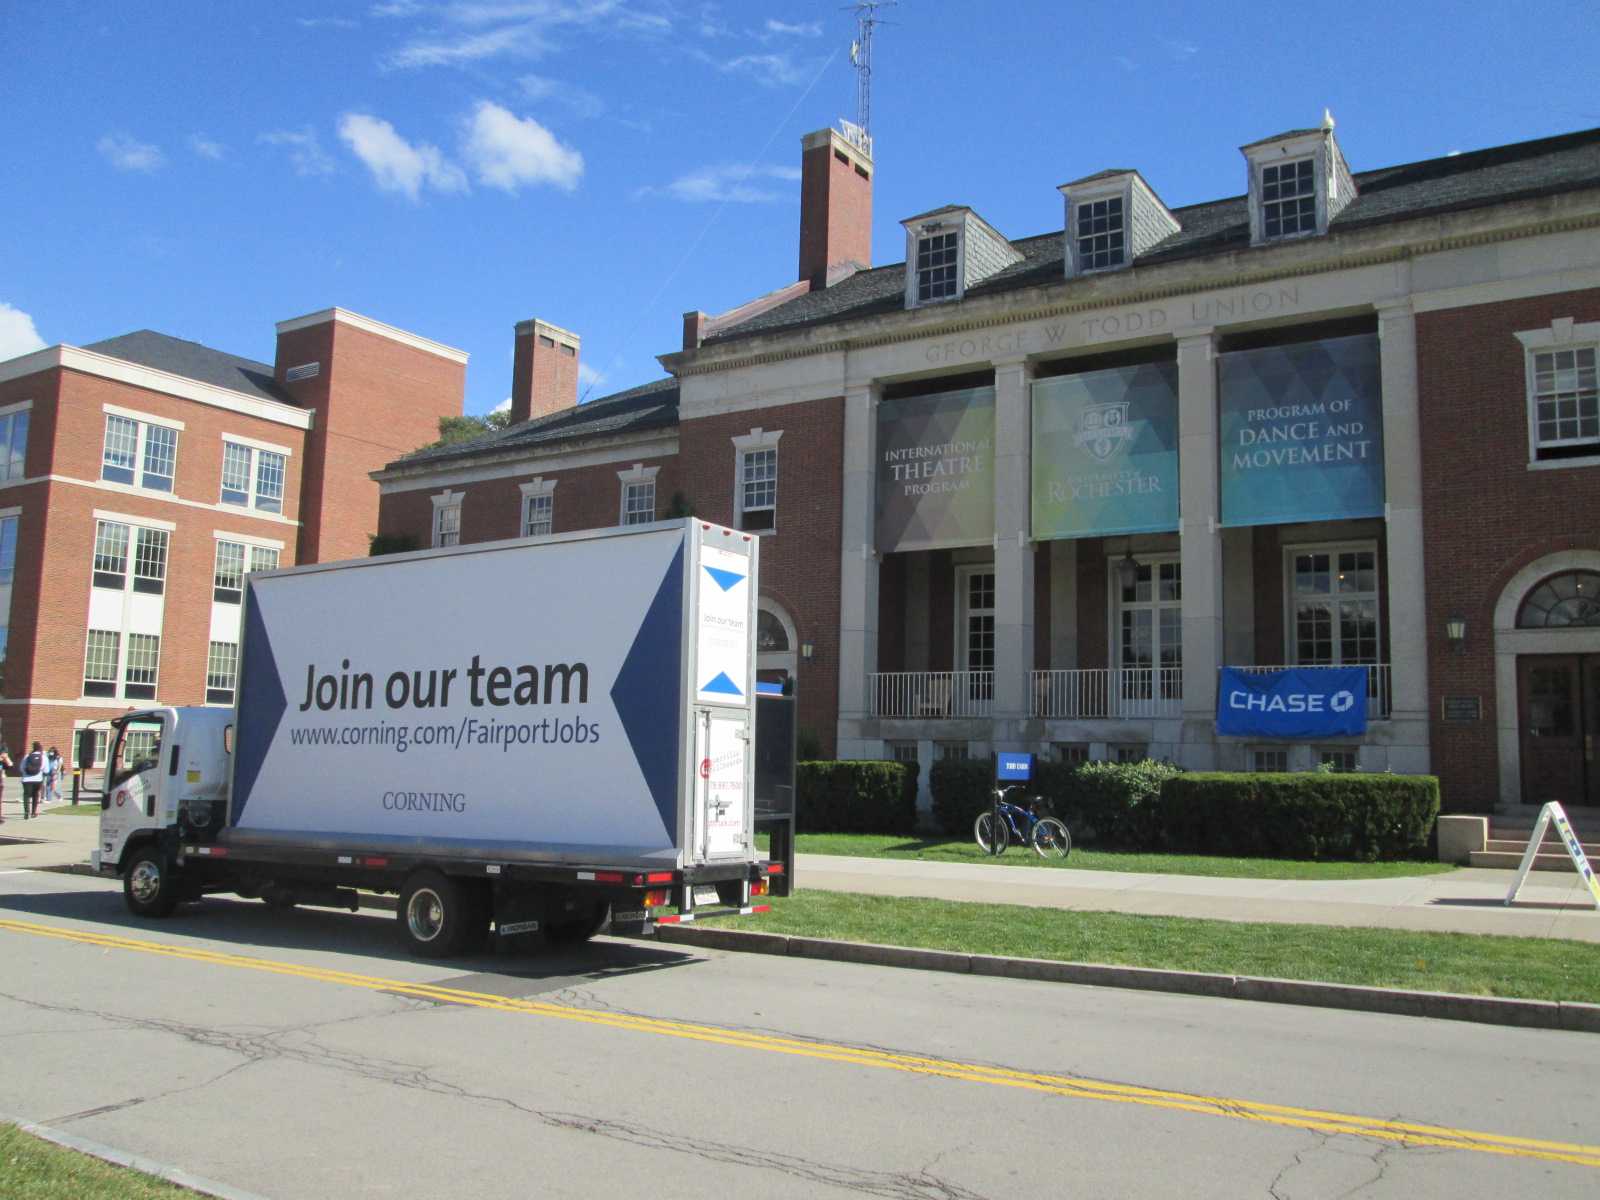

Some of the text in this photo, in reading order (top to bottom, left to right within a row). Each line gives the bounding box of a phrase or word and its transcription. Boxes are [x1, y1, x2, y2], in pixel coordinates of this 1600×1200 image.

[925, 286, 1300, 363] GEORGE W TODD UNION
[1247, 399, 1352, 421] PROGRAM OF
[1239, 421, 1364, 446] DANCE AND
[884, 439, 994, 462] INTERNATIONAL
[1232, 440, 1371, 470] MOVEMENT
[890, 455, 985, 481] THEATRE
[1067, 470, 1130, 484] UNIVERSITY
[904, 480, 971, 496] PROGRAM
[1047, 476, 1162, 504] ROCHESTER
[703, 612, 716, 623] Join
[717, 617, 728, 625] our
[728, 617, 744, 629] team
[299, 654, 589, 712] Join our team
[1229, 690, 1325, 712] CHASE
[291, 715, 600, 753] www.corning.com/FairportJobs
[382, 791, 466, 813] CORNING
